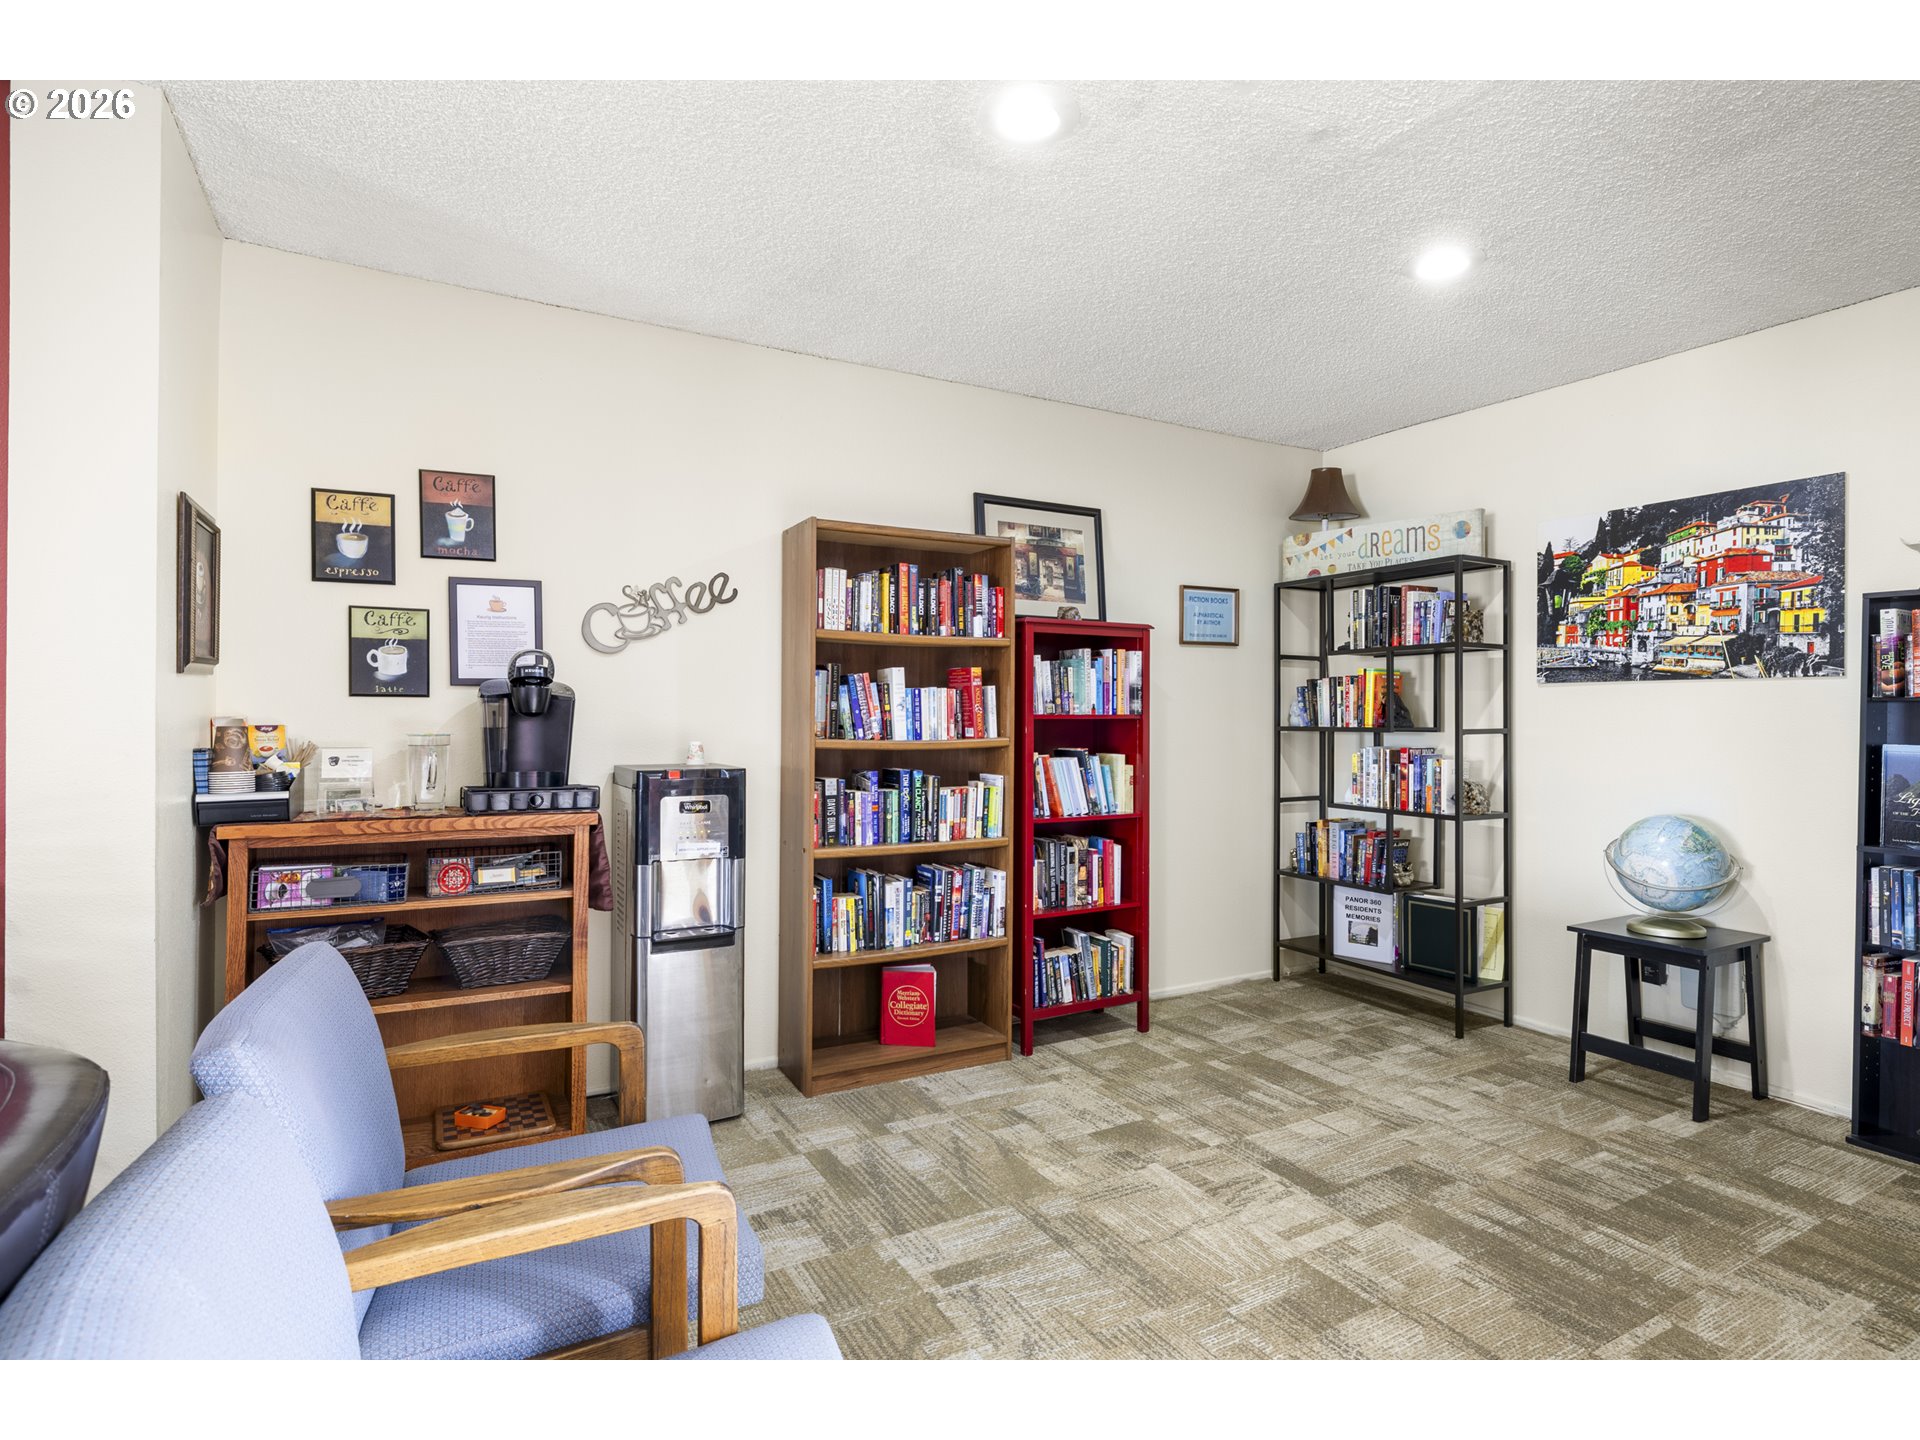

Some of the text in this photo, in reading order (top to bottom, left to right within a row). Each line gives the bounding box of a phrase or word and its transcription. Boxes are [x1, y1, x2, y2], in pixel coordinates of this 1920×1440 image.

[437, 546, 478, 556] mocha
[325, 567, 379, 577] espresso
[1882, 655, 1890, 670] EVE
[375, 684, 404, 693] latte
[1893, 792, 1920, 808] Lig
[827, 799, 835, 815] DAVIS
[1345, 896, 1369, 904] PANOR
[1345, 905, 1382, 914] RESIDENTS
[1346, 914, 1381, 923] MEMORIES
[890, 1001, 928, 1010] Collegiate
